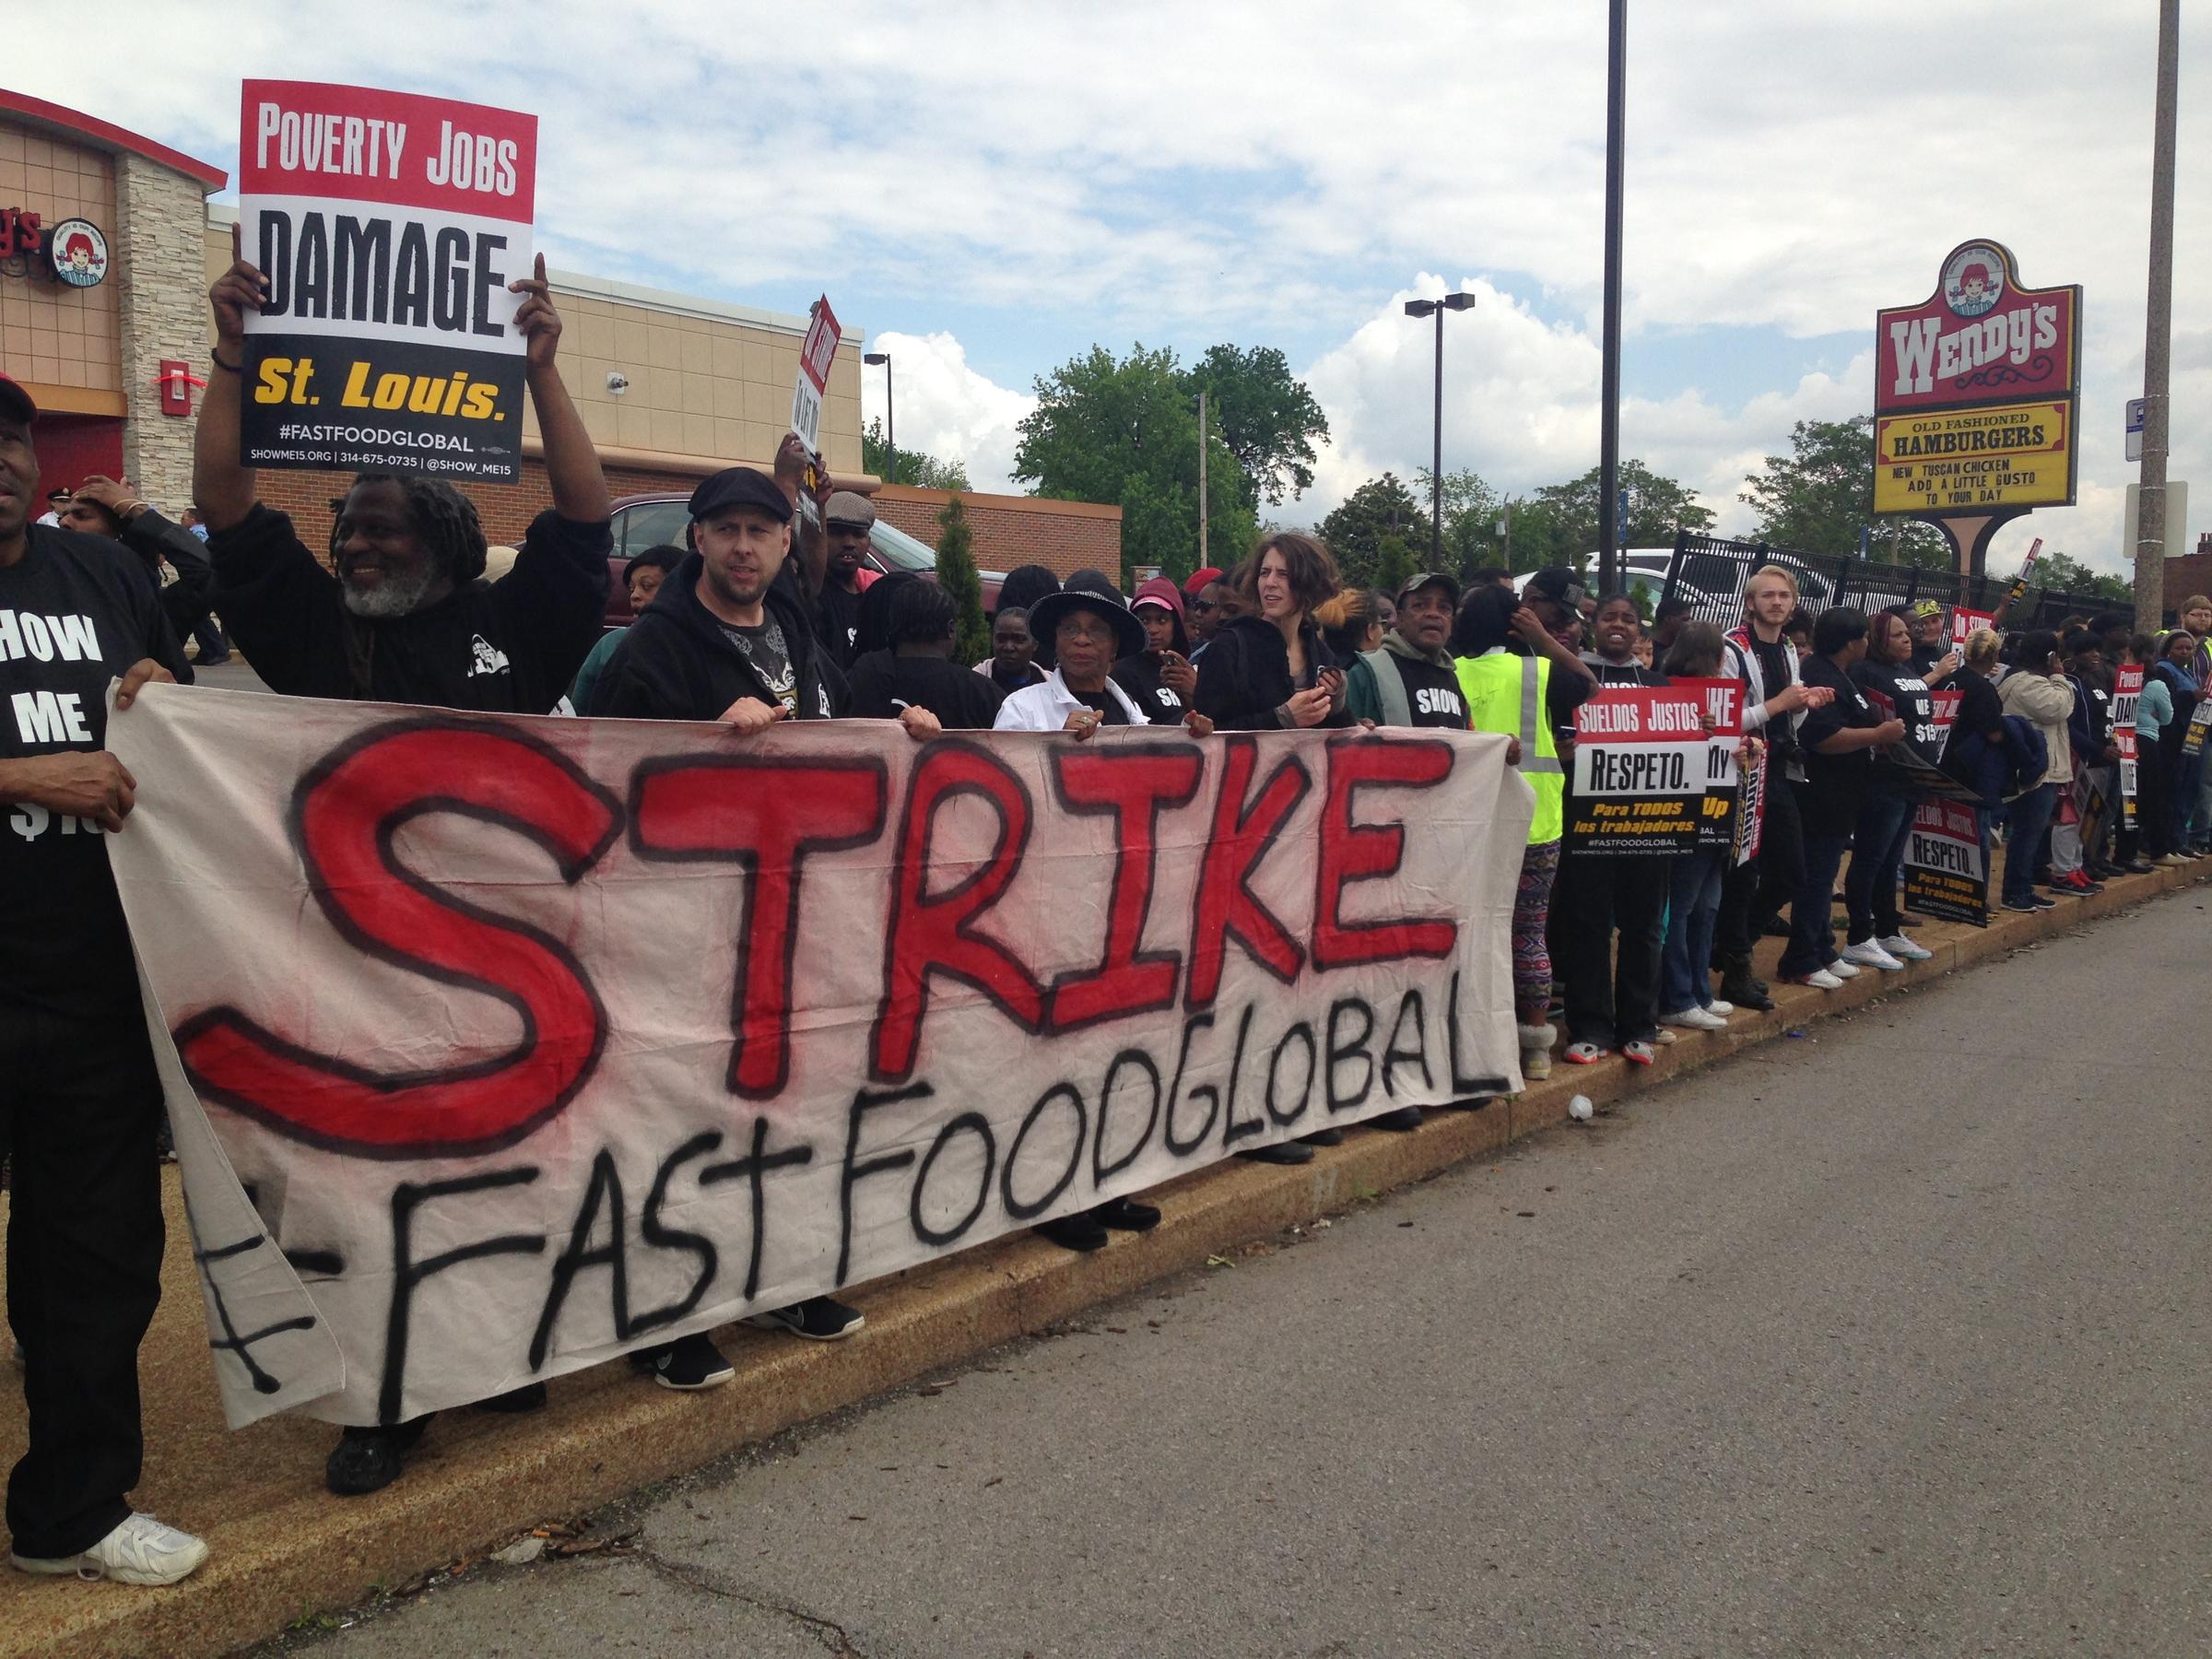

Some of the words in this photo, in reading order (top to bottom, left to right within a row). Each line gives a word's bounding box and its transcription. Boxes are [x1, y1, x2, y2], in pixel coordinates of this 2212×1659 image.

[257, 102, 407, 180] POVERTY
[427, 120, 517, 196] JOBS
[259, 209, 509, 337] DAMAGE
[254, 358, 320, 406] St.
[341, 360, 506, 421] Louis.
[1912, 422, 1941, 433] OLD
[1947, 413, 2030, 429] FASHIONED
[279, 424, 474, 453] #FASTFOODGLOBAL
[1893, 425, 2044, 457] HAMBURGERS
[251, 449, 332, 462] SHOWME15.ORG
[340, 452, 418, 467] 314-675-0735
[427, 458, 512, 476] @SHOW_ME15
[1892, 466, 1913, 479] NEW
[1923, 463, 1960, 477] TUSCAN
[1963, 459, 2010, 474] CHICKEN
[1908, 479, 1932, 492] ADD
[1941, 478, 1947, 490] A
[1954, 476, 1986, 489] LITTLE
[1996, 471, 2035, 486] GUSTO
[1926, 493, 1937, 505] TO
[1947, 490, 1971, 503] YOUR
[1980, 489, 2002, 502] DAY
[0, 609, 103, 662] HOW
[1156, 688, 1182, 707] SH
[1894, 678, 1928, 691] SHOW
[1416, 688, 1462, 716] SHOW
[1916, 699, 1930, 715] ME
[11, 691, 93, 743] ME
[1579, 701, 1639, 733] SUELDOS
[1590, 748, 1689, 791] RESPETO.
[1593, 804, 1629, 817] Para
[1632, 802, 1684, 816] TODOS
[1701, 797, 1729, 818] Up
[1741, 767, 1759, 853] AMAGE
[1916, 804, 1943, 827] ELDOS
[1573, 820, 1597, 833] los
[1600, 820, 1696, 835] trabajadores.
[1588, 839, 1677, 847] #FASTFOODGLOBAL
[1912, 833, 1974, 876] RESPETO.
[173, 716, 1459, 1162] STRIKE
